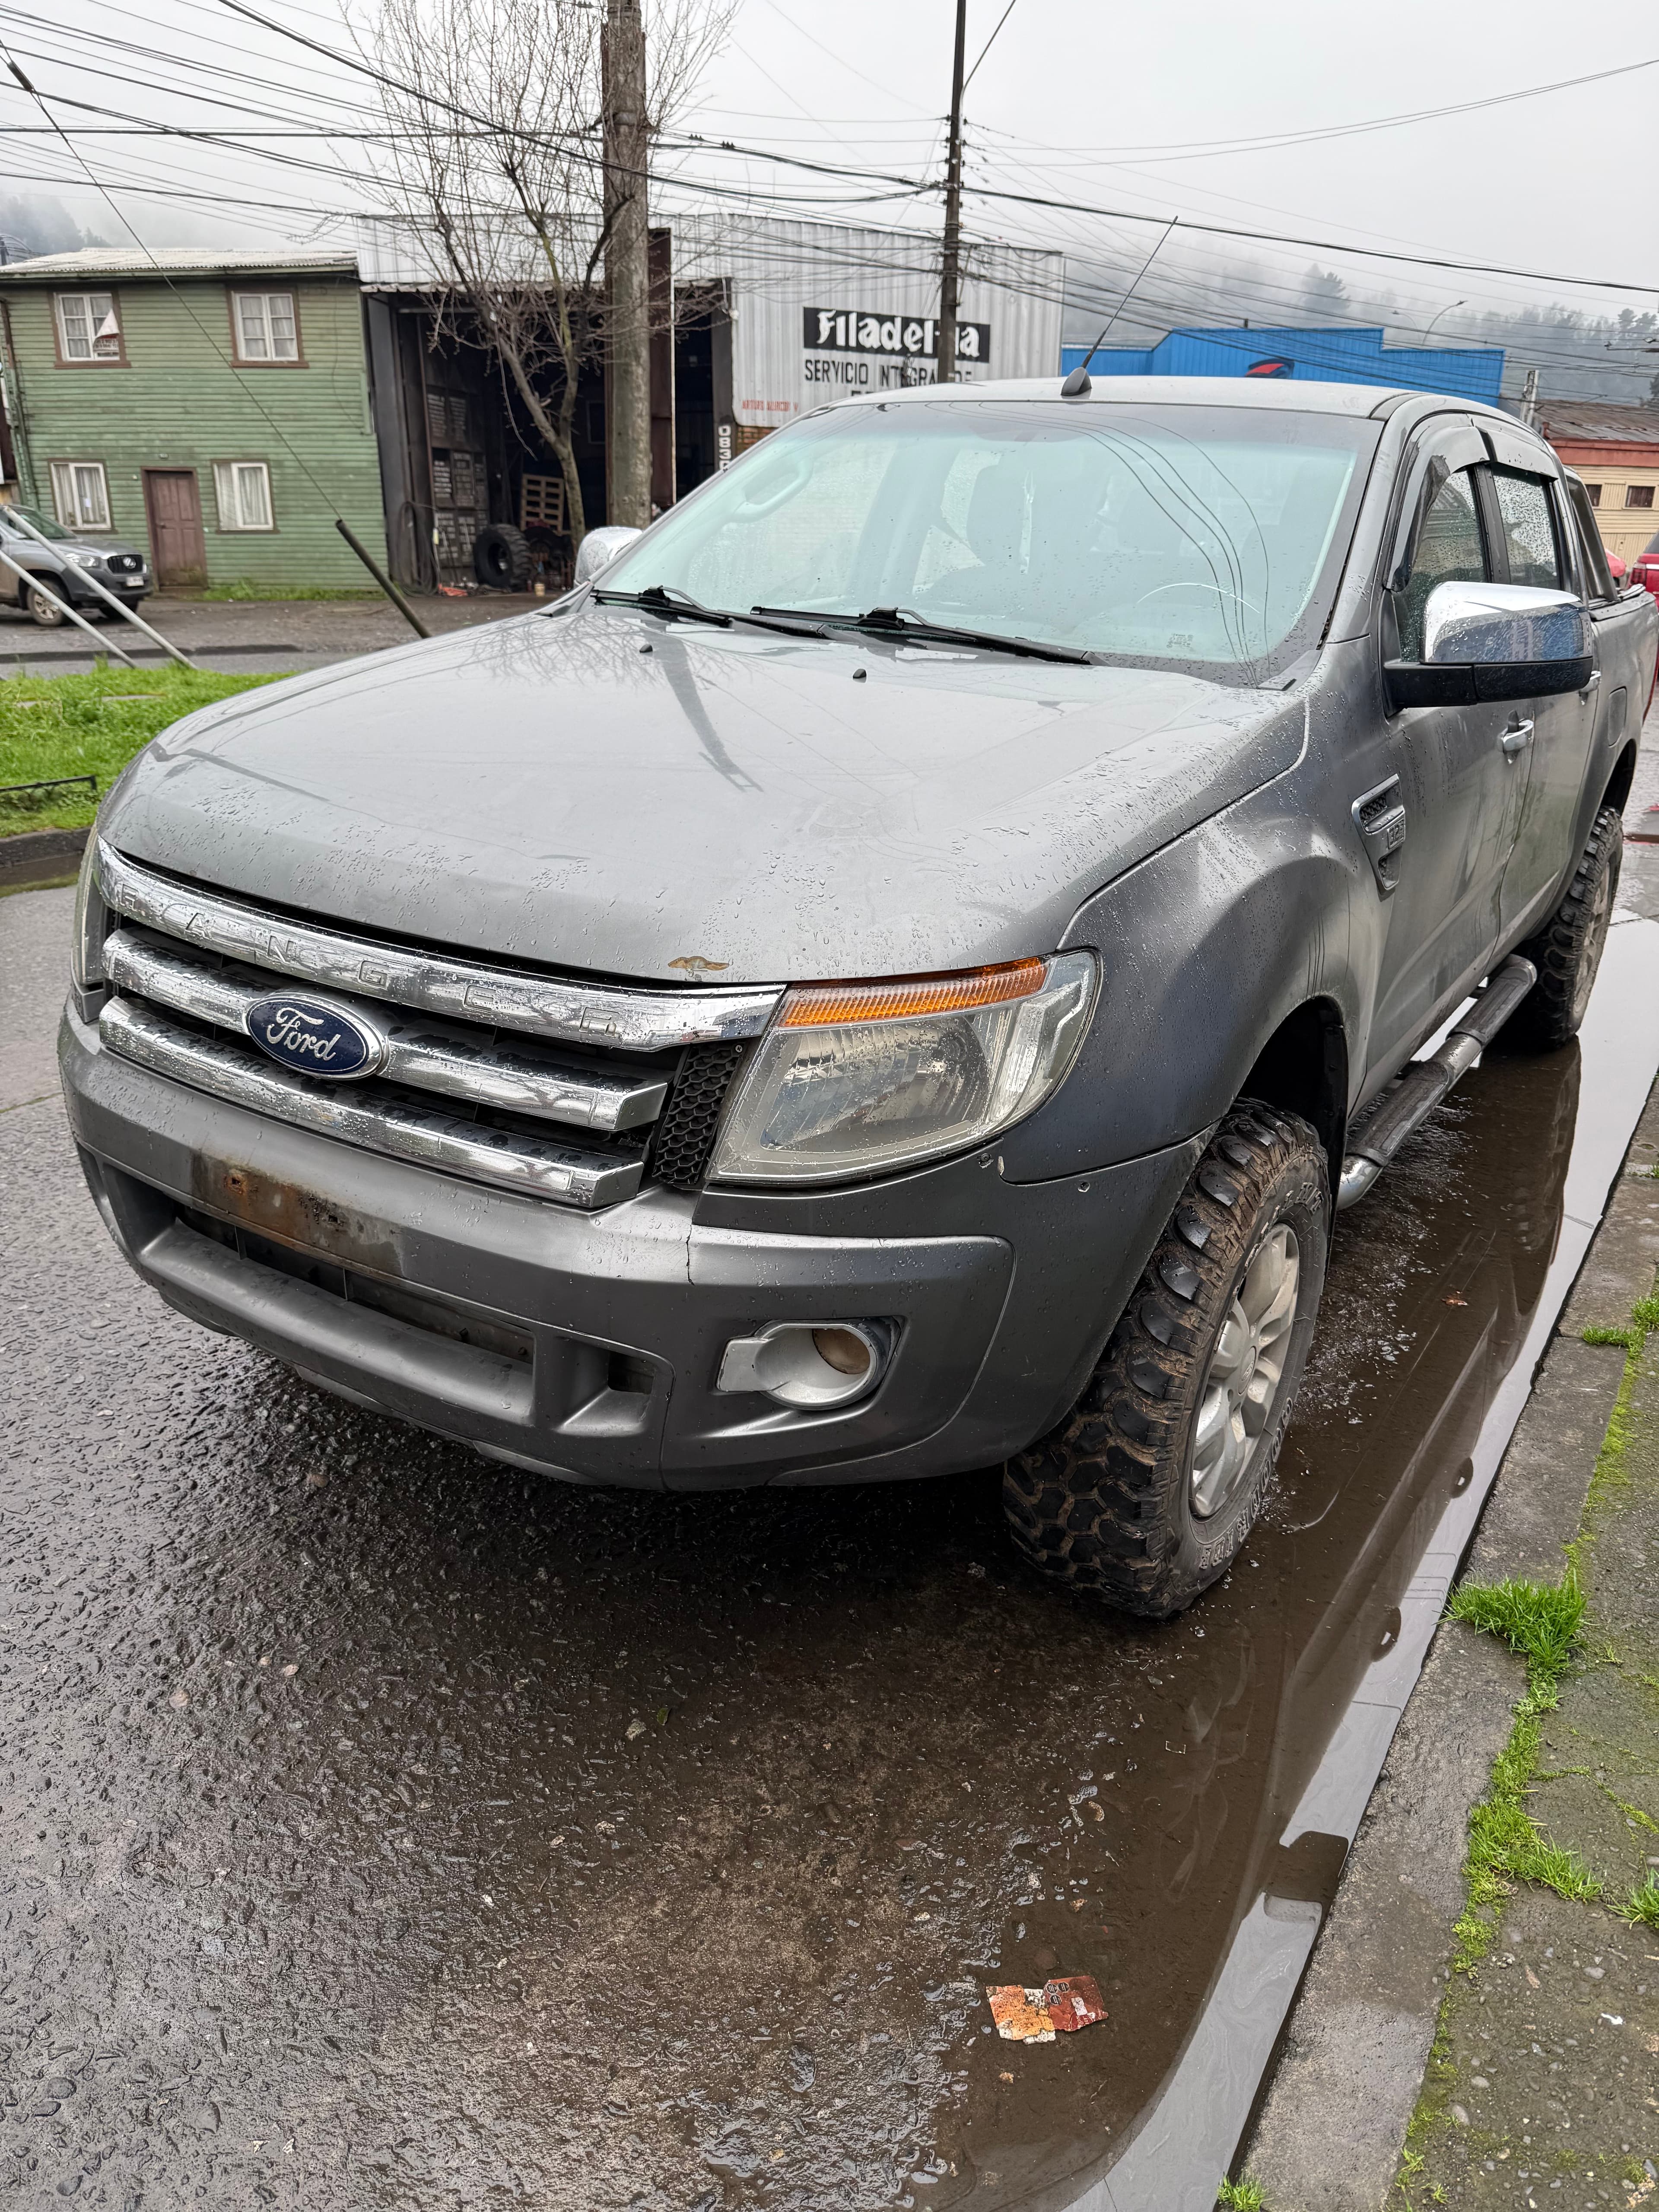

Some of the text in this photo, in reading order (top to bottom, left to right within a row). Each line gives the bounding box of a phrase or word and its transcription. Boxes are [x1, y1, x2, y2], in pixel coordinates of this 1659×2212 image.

[816, 309, 980, 358] Filadelia
[805, 359, 868, 385] SERVICIO
[266, 1007, 341, 1061] Ford
